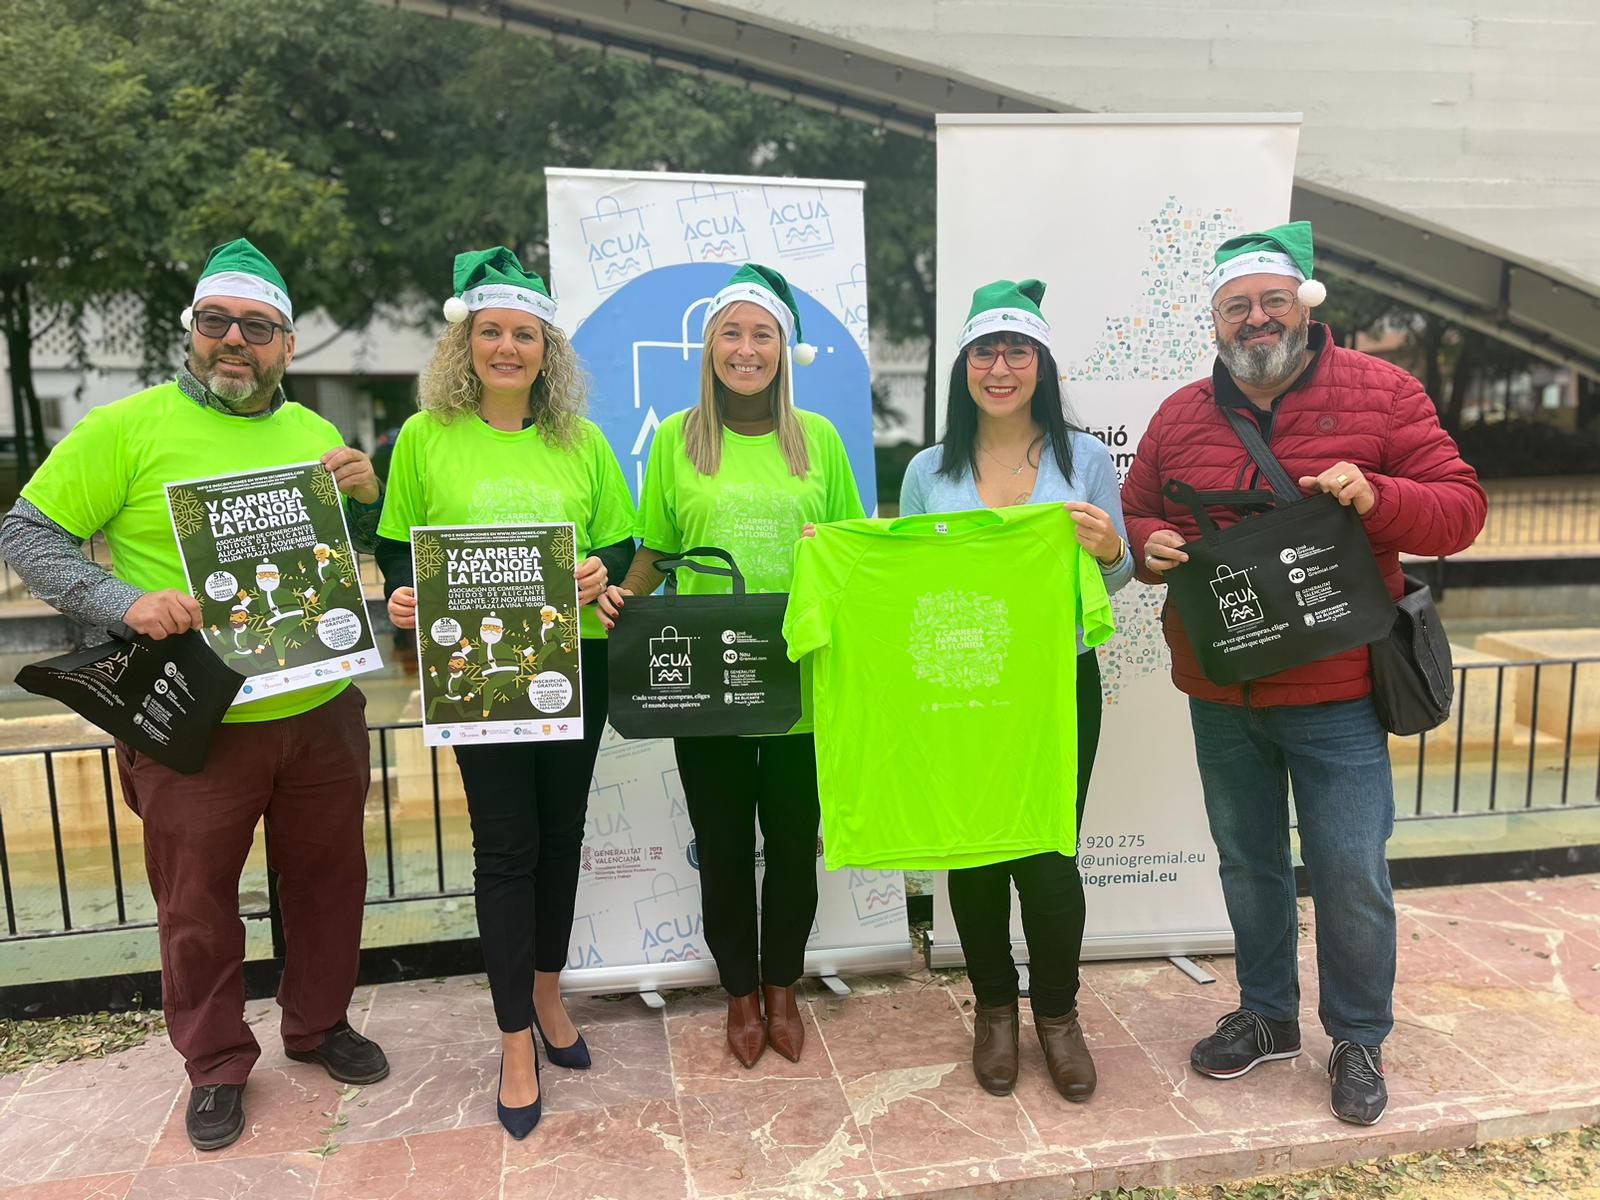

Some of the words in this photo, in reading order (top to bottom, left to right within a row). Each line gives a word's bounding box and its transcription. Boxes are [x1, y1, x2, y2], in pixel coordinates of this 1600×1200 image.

[769, 200, 829, 226] ACUA
[684, 215, 746, 241] ACUA
[588, 231, 651, 263] ACUA
[844, 306, 868, 325] AC
[1085, 425, 1128, 446] nió
[205, 500, 218, 513] V
[221, 487, 304, 511] CARRERA
[208, 507, 257, 526] PAPA
[257, 498, 308, 517] NOEL
[211, 523, 236, 538] LA
[236, 509, 311, 534] FLORIDA
[741, 517, 779, 525] CARRERA
[756, 524, 777, 532] NOEL
[215, 532, 256, 547] ASOCIACIÓN
[264, 523, 314, 537] COMERCIANTES
[215, 540, 253, 552] UNIDOS
[271, 528, 315, 541] ALICANTE
[744, 530, 778, 538] FLORIDA
[217, 544, 257, 558] ALICANTE
[270, 533, 317, 548] NOVIEMBRE
[218, 555, 243, 564] SALIDA
[246, 550, 268, 558] PLAZA
[446, 548, 459, 561] V
[461, 546, 541, 561] CARRERA
[447, 559, 493, 573] PAPA
[495, 558, 543, 572] NOEL
[1306, 565, 1320, 573] Nou
[213, 572, 226, 580] 5K
[448, 572, 470, 585] LA
[472, 570, 544, 584] FLORIDA
[448, 586, 487, 594] ASOCIACIÓN
[497, 584, 545, 592] COMERCIANTES
[1302, 581, 1331, 594] GENERALITAT
[1304, 586, 1332, 598] VALENCIANA
[448, 598, 486, 606] ALICANTE
[501, 595, 546, 603] NOVIEMBRE
[1219, 586, 1258, 610] ACUA
[320, 613, 354, 624] INSCRIPCIÓN
[325, 619, 351, 628] GRATUITA
[1212, 639, 1227, 648] Cada
[1236, 635, 1246, 643] que
[1272, 622, 1290, 631] eliges
[948, 641, 985, 650] FLORIDA
[1224, 646, 1229, 654] el
[1229, 642, 1248, 652] mundo
[1248, 640, 1259, 648] que
[1258, 634, 1282, 645] quieres
[648, 653, 692, 668] ACUA
[656, 694, 668, 702] que
[668, 702, 679, 710] que
[680, 701, 701, 710] quieres
[1086, 835, 1114, 848] 920
[1118, 834, 1145, 848] 275
[594, 848, 642, 857] GENERALITAT
[595, 856, 641, 864] VALENCIANA
[567, 944, 604, 970] UA
